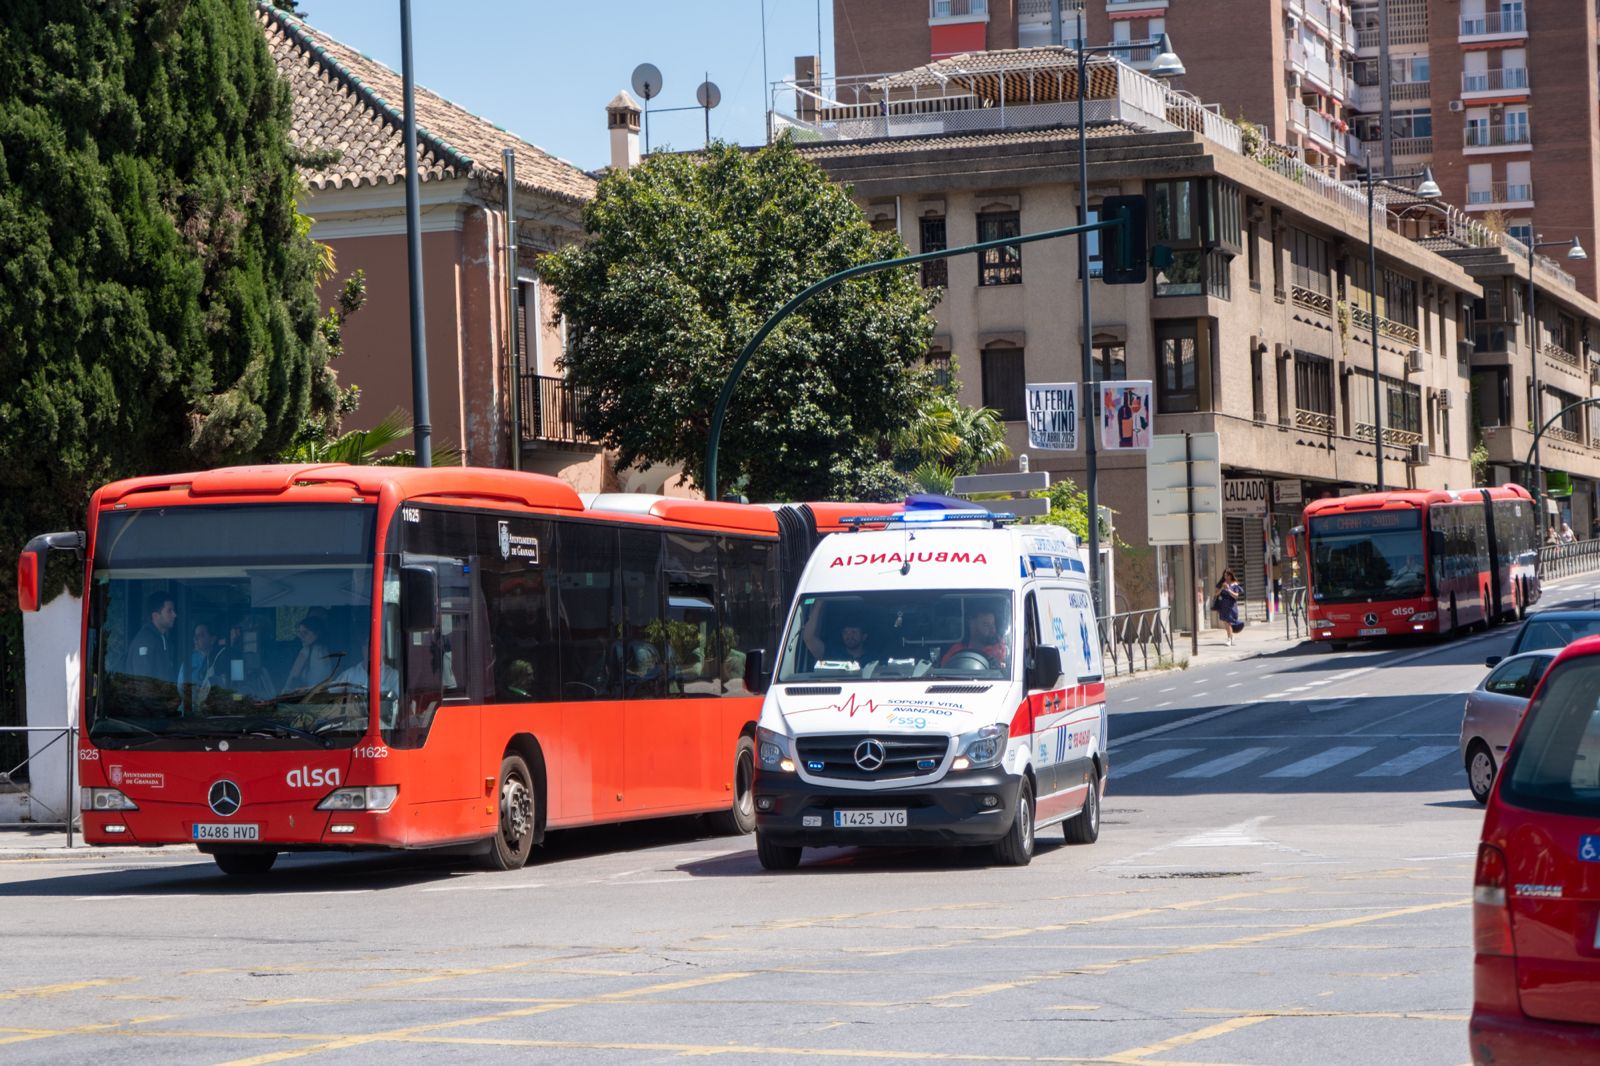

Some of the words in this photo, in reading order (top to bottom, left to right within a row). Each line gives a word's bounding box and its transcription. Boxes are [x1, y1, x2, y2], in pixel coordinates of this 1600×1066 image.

[1030, 390, 1041, 410] LA
[1045, 389, 1075, 410] FERIA
[1030, 411, 1047, 432] DEL
[1051, 411, 1075, 432] VINO
[1047, 432, 1060, 443] ABRIL
[1061, 432, 1075, 443] 2025
[1224, 481, 1265, 501] CALZADO
[402, 507, 420, 523] 11625
[1391, 606, 1415, 616] alsa
[893, 707, 953, 717] AVANZADO
[352, 746, 389, 759] 11625
[286, 765, 341, 788] alsa
[842, 812, 875, 825] 1425
[880, 812, 905, 825] JYG
[200, 826, 230, 839] 3486
[233, 826, 257, 839] HVD
[1514, 883, 1563, 897] TOURAN
